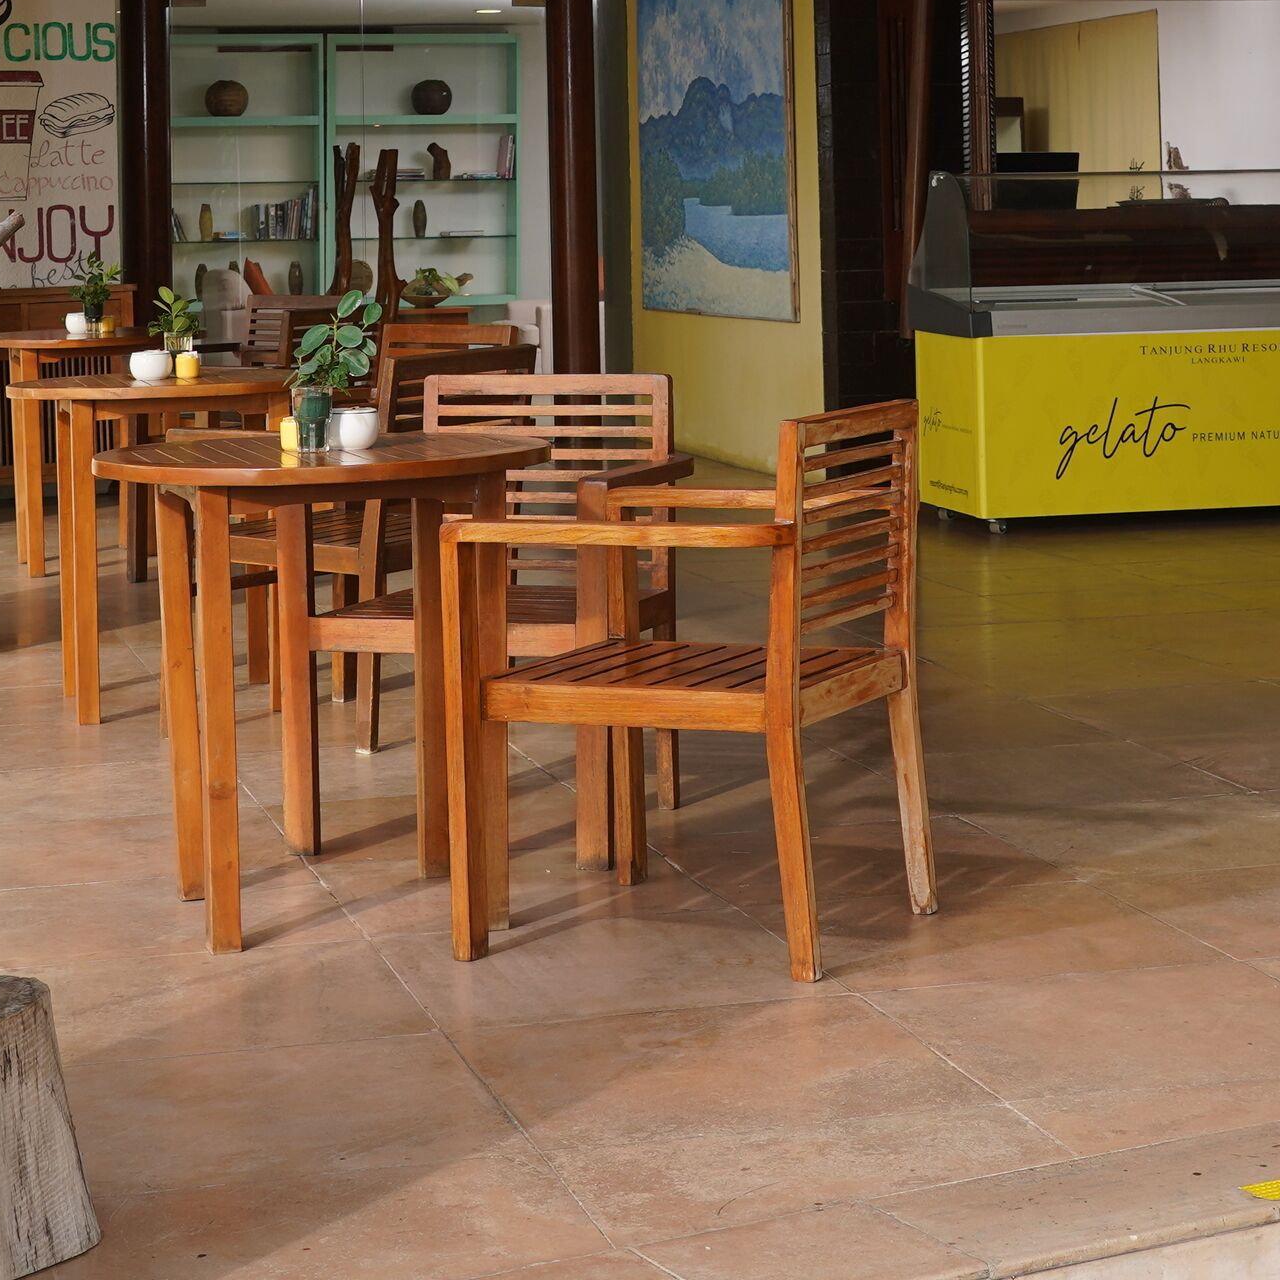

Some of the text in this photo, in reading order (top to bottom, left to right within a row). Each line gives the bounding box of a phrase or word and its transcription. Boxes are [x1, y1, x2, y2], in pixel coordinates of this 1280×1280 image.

[24, 140, 106, 168] Latte
[1139, 344, 1203, 356] TANJUNG
[1207, 343, 1237, 354] RHU
[1191, 356, 1247, 364] LANGKAWI
[1056, 396, 1191, 480] gelato
[1192, 431, 1246, 442] PREMIUM
